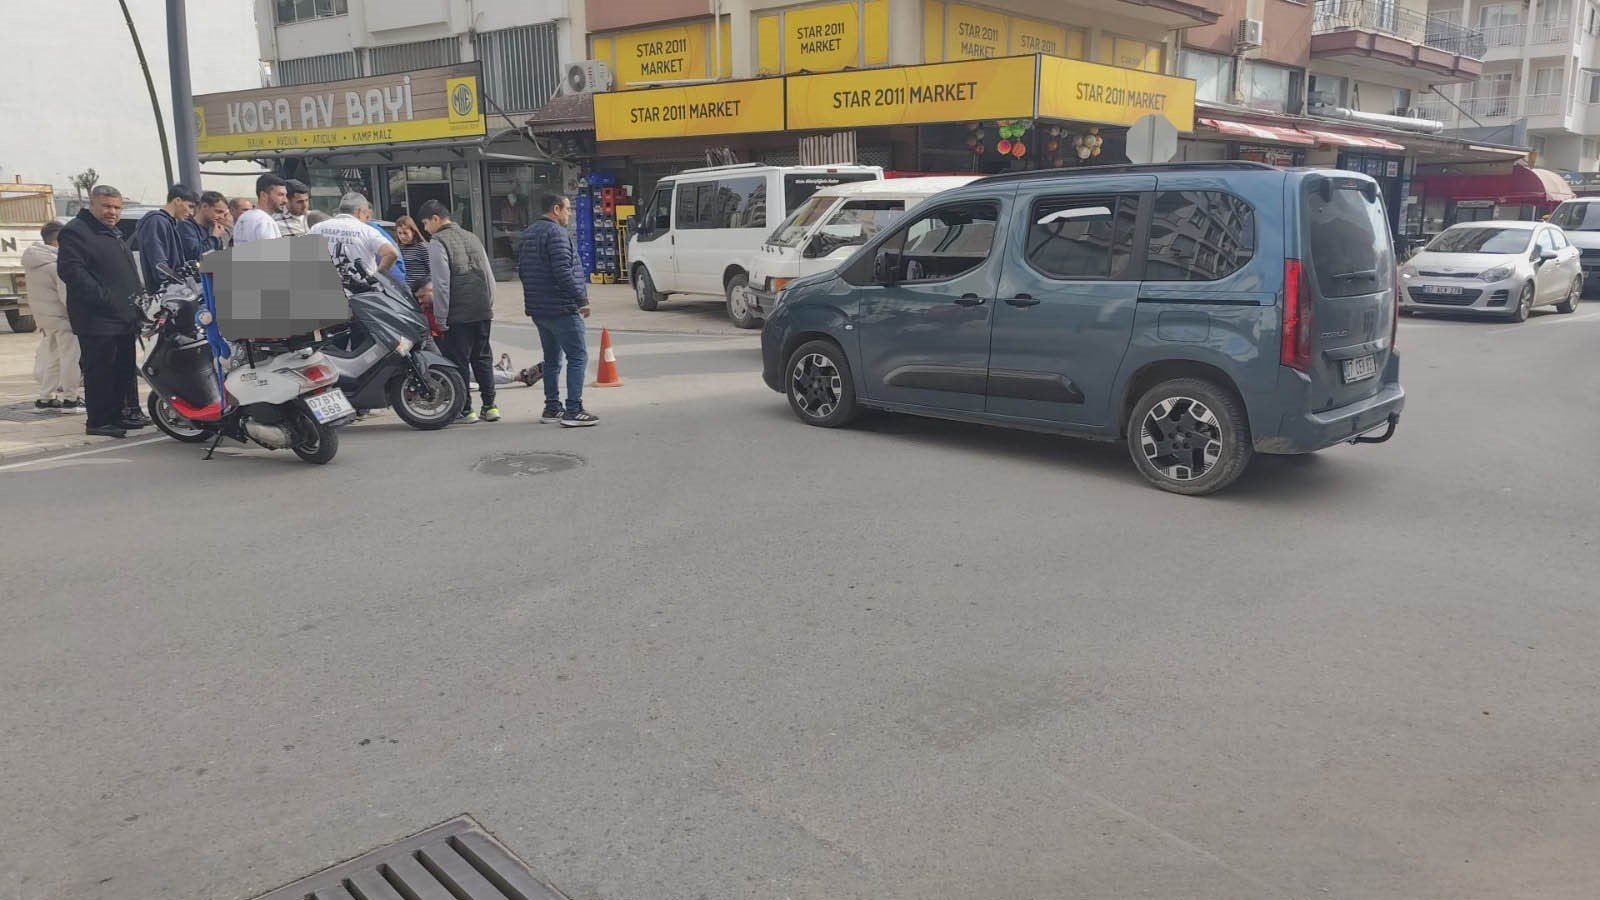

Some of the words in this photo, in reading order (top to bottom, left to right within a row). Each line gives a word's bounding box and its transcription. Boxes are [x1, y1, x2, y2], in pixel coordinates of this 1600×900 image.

[797, 25, 822, 39] STAR
[824, 22, 845, 36] 2011
[958, 22, 981, 39] STAR
[982, 26, 999, 41] 2011
[636, 41, 663, 58] STAR
[665, 39, 687, 54] 2011
[800, 38, 842, 55] MARKET
[961, 41, 996, 59] MARKET
[1020, 34, 1040, 51] STAR
[641, 58, 684, 75] MARKET
[833, 90, 871, 109] STAR
[875, 87, 905, 106] 2011
[909, 81, 978, 104] MARKET
[1076, 82, 1103, 104] STAR
[1105, 86, 1125, 106] 2011
[1127, 90, 1167, 112] MARKET
[227, 98, 292, 134] KOCA
[300, 93, 336, 129] AV
[630, 106, 660, 123] STAR
[663, 104, 686, 121] 2011
[689, 100, 741, 119] MARKET
[321, 403, 342, 416] 569
